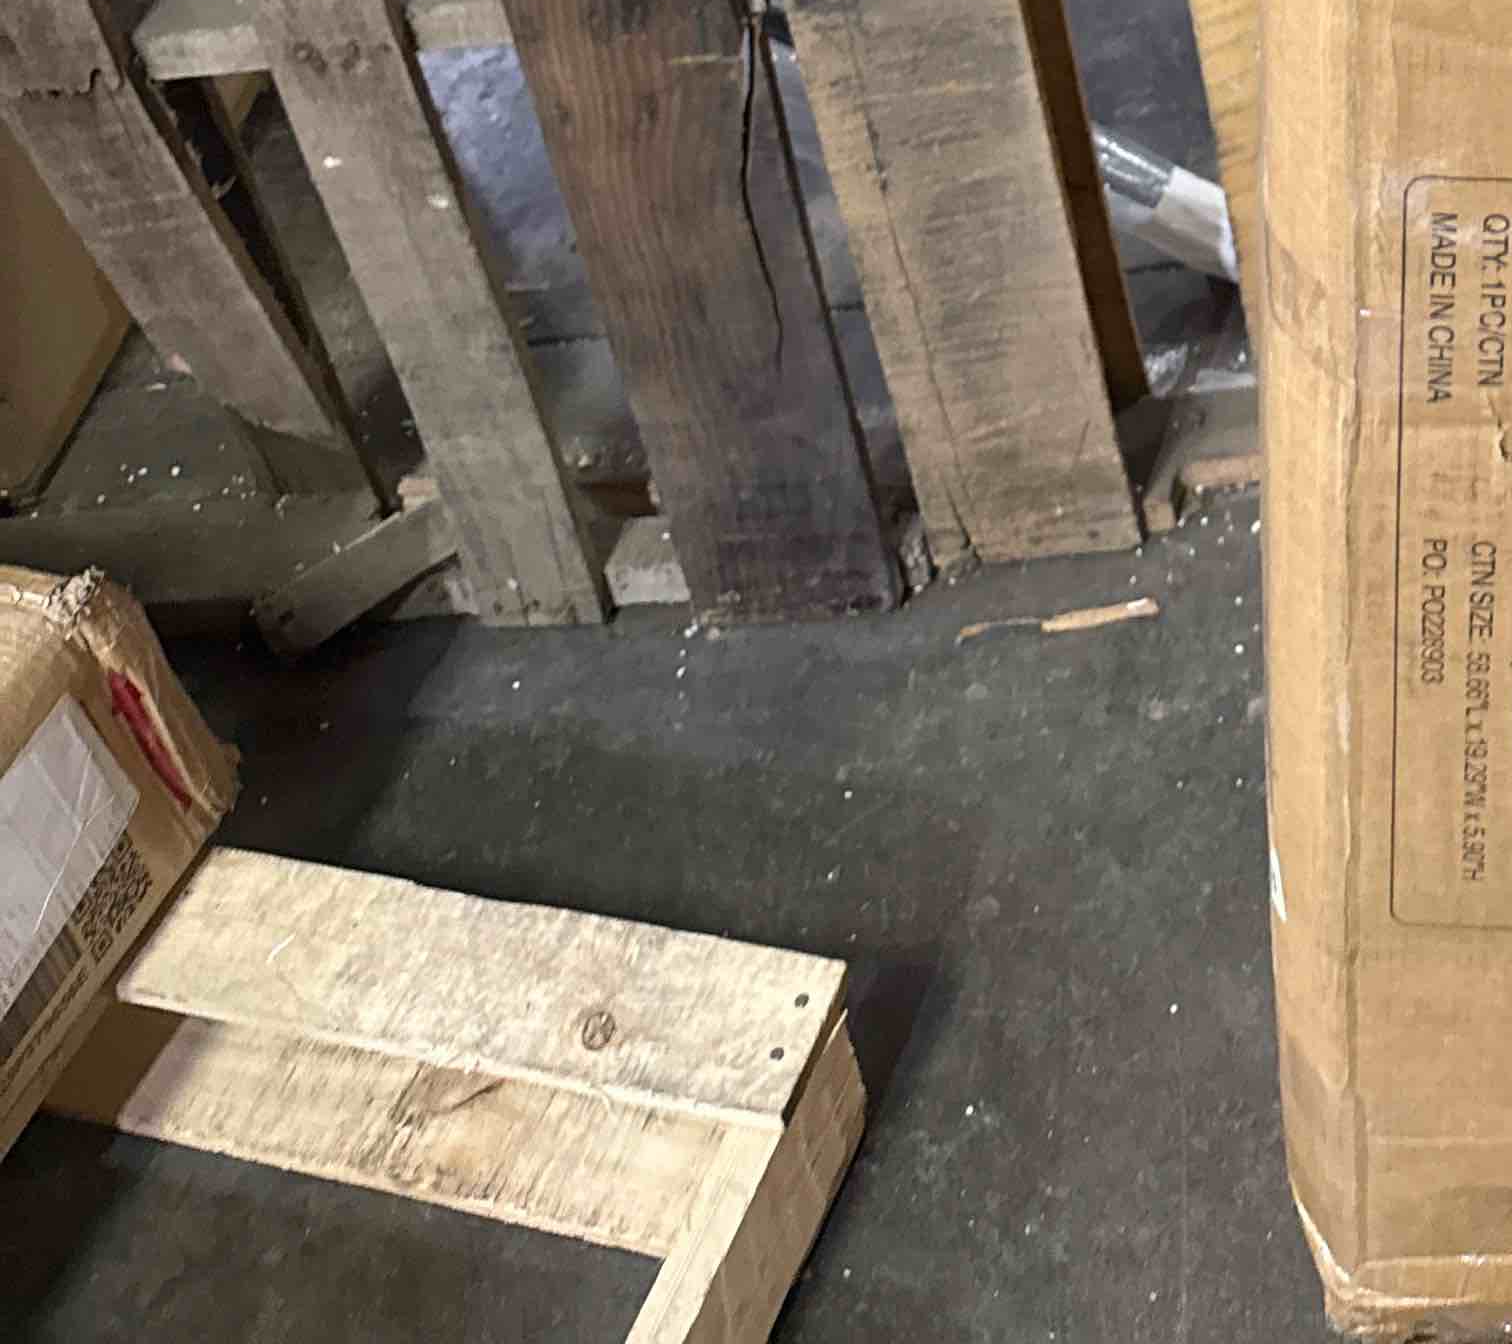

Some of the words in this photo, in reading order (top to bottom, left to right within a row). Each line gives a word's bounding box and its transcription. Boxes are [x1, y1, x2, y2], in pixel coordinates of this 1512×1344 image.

[1430, 212, 1457, 289] MADE
[1480, 213, 1510, 271] QTY:
[1429, 294, 1454, 320] IN
[1476, 282, 1507, 387] 1PC/CTN
[1426, 324, 1453, 404] CHINA
[1421, 538, 1449, 577] PO:
[1468, 540, 1498, 589] CTN
